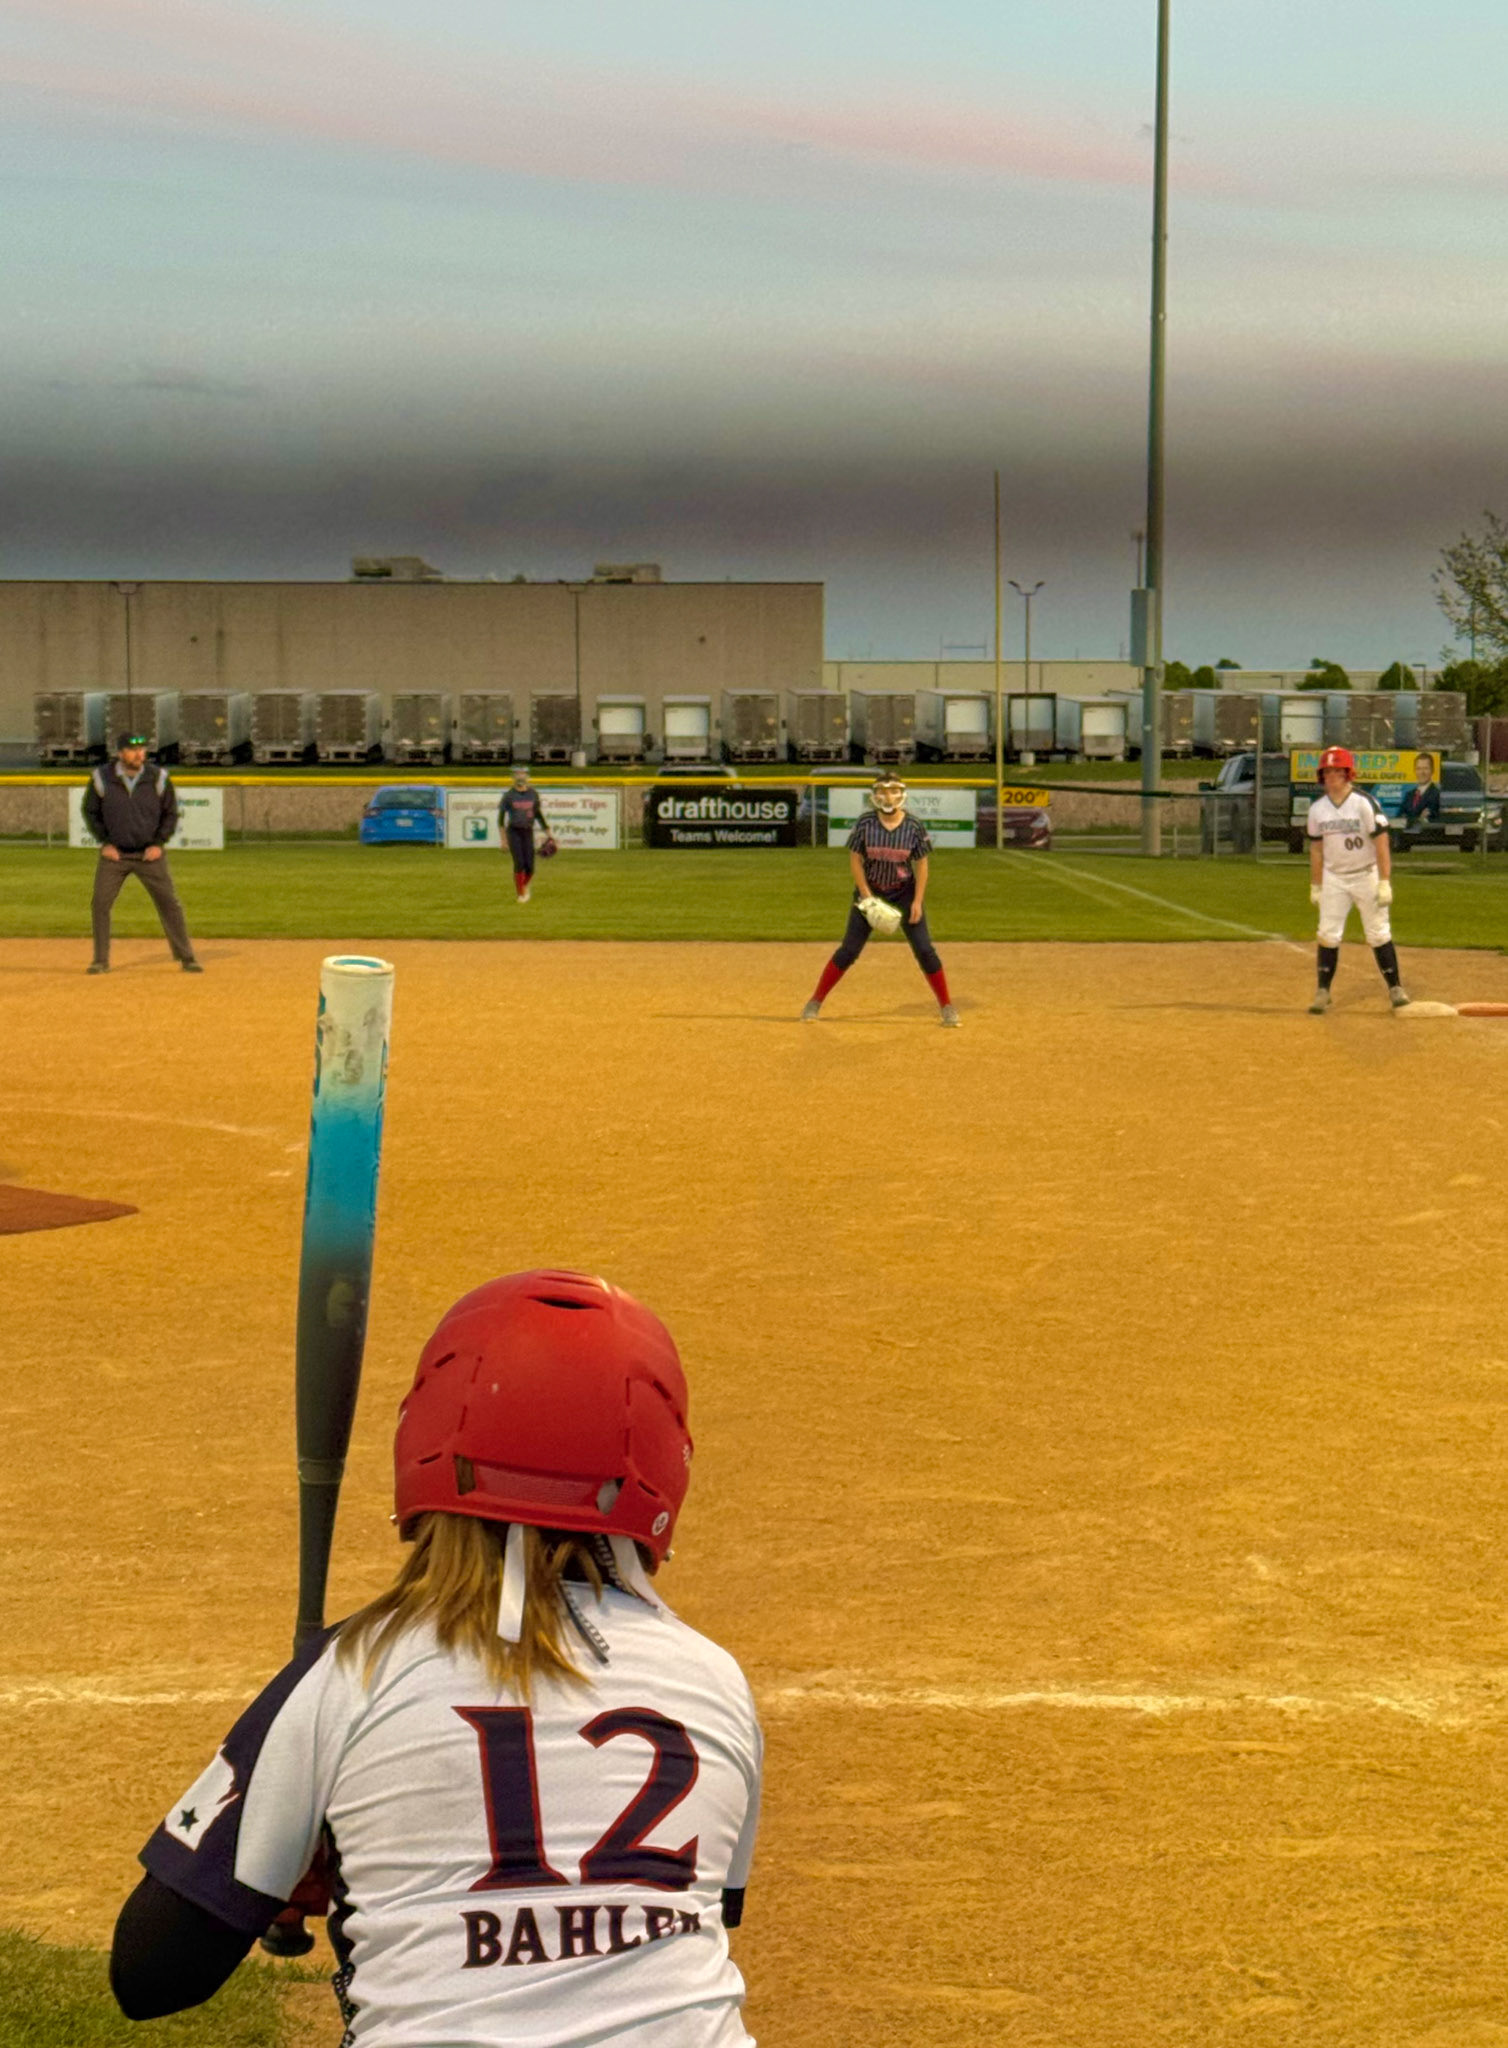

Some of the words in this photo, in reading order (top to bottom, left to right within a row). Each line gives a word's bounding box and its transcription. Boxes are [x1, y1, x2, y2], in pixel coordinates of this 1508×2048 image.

[1298, 753, 1400, 769] INRED?
[1003, 790, 1036, 804] 200
[657, 796, 789, 819] drafthouse
[670, 829, 713, 842] Teams
[714, 829, 777, 842] Welcome!
[1344, 836, 1364, 851] 00
[451, 1706, 700, 1892] 12
